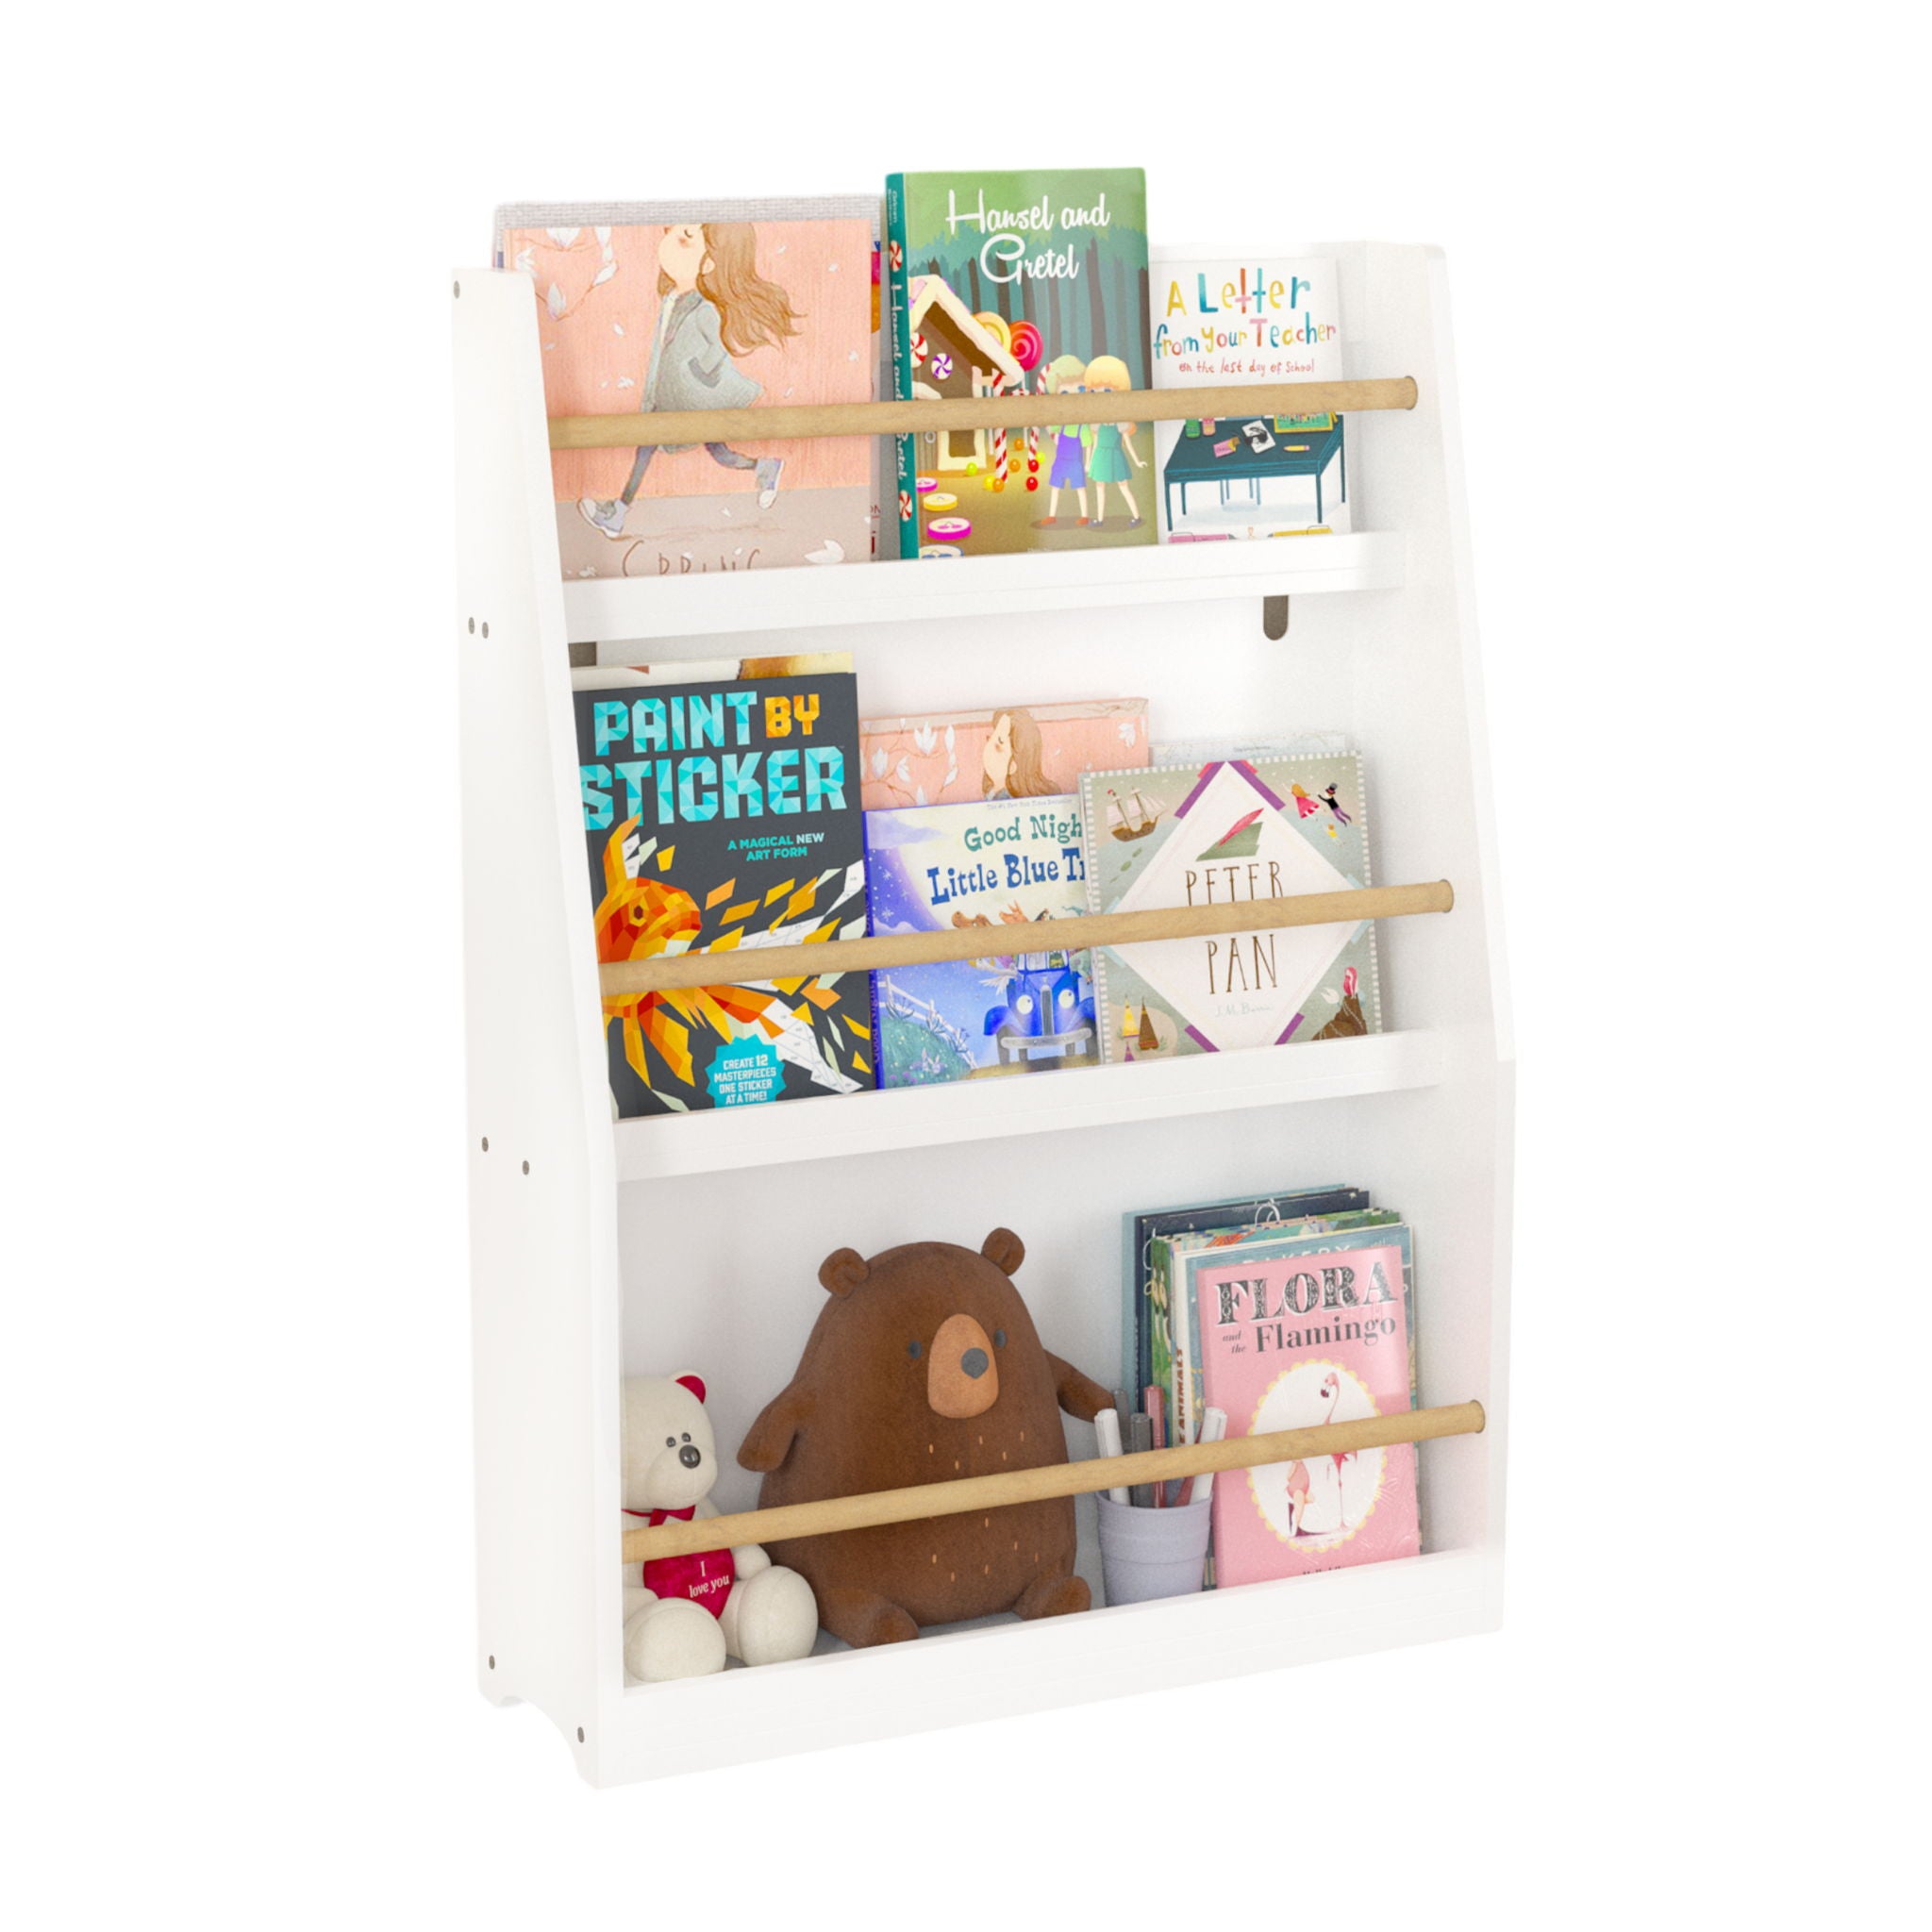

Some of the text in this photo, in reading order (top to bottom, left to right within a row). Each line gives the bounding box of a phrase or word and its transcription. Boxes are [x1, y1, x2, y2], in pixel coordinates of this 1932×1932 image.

[945, 188, 1054, 235] Hansel
[1060, 192, 1110, 230] and
[979, 232, 1079, 285] Gretel
[1167, 268, 1311, 317] A Letter
[1153, 311, 1336, 359] from your Teacher
[1178, 357, 1315, 377] on the last day of School
[593, 691, 820, 757] PAINT BY
[579, 746, 847, 830] STICKER
[726, 832, 825, 851] A MAGICAL NEW
[964, 813, 1083, 852] Good Nigh
[746, 845, 808, 861] ART FORM
[926, 863, 998, 906] Little
[1003, 853, 1059, 889] Blue
[1205, 933, 1277, 995] PAN
[714, 1066, 777, 1083] MASTERPIECES
[723, 1054, 769, 1071] CREATE 12
[719, 1078, 773, 1094] ONE STICKER
[725, 1091, 768, 1106] AT A TIME!
[1214, 1261, 1398, 1327] FLORA
[1223, 1316, 1396, 1354] and Flamingo
[1230, 1344, 1246, 1355] the
[1175, 1348, 1186, 1429] ANIMALS
[689, 1574, 730, 1599] love you
[699, 1560, 707, 1577] I
